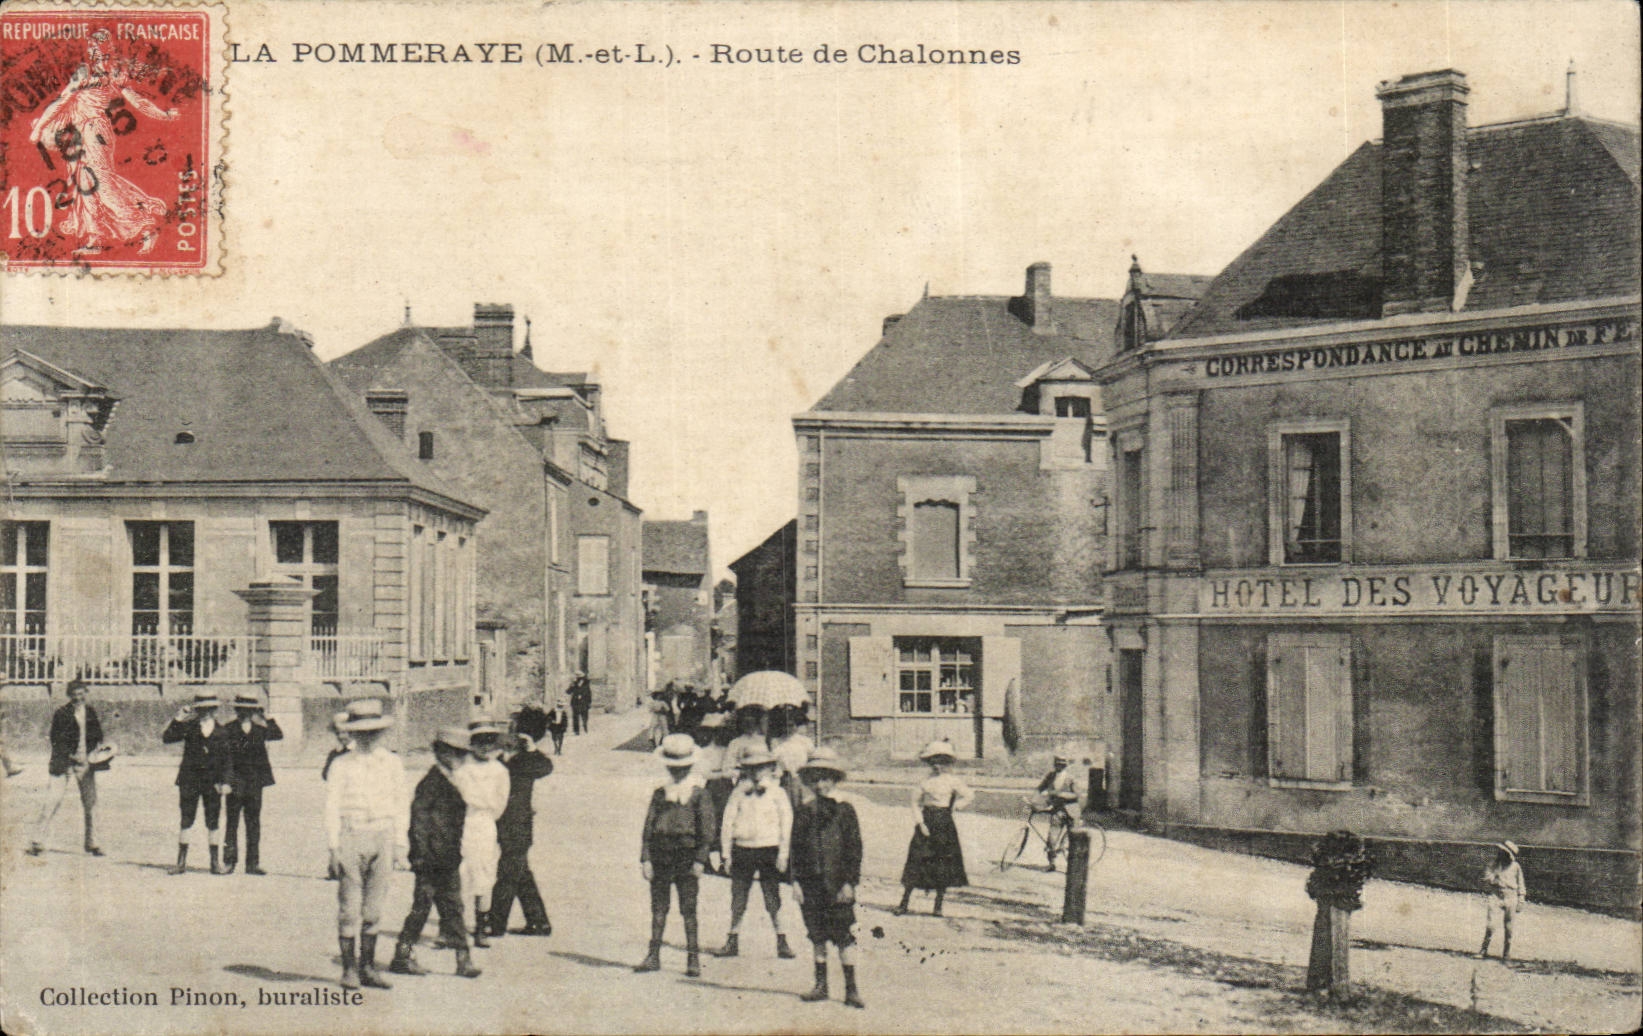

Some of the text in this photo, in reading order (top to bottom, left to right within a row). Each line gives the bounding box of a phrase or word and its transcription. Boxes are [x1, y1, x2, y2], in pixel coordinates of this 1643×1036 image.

[116, 22, 200, 42] FRANÇAISE
[3, 186, 53, 239] 10
[176, 168, 199, 252] POSTES
[1206, 337, 1427, 377] CORRESPONDANCE
[1458, 326, 1560, 356] CHEMIN
[1210, 577, 1321, 608] HOTEL
[1341, 576, 1412, 607] DES
